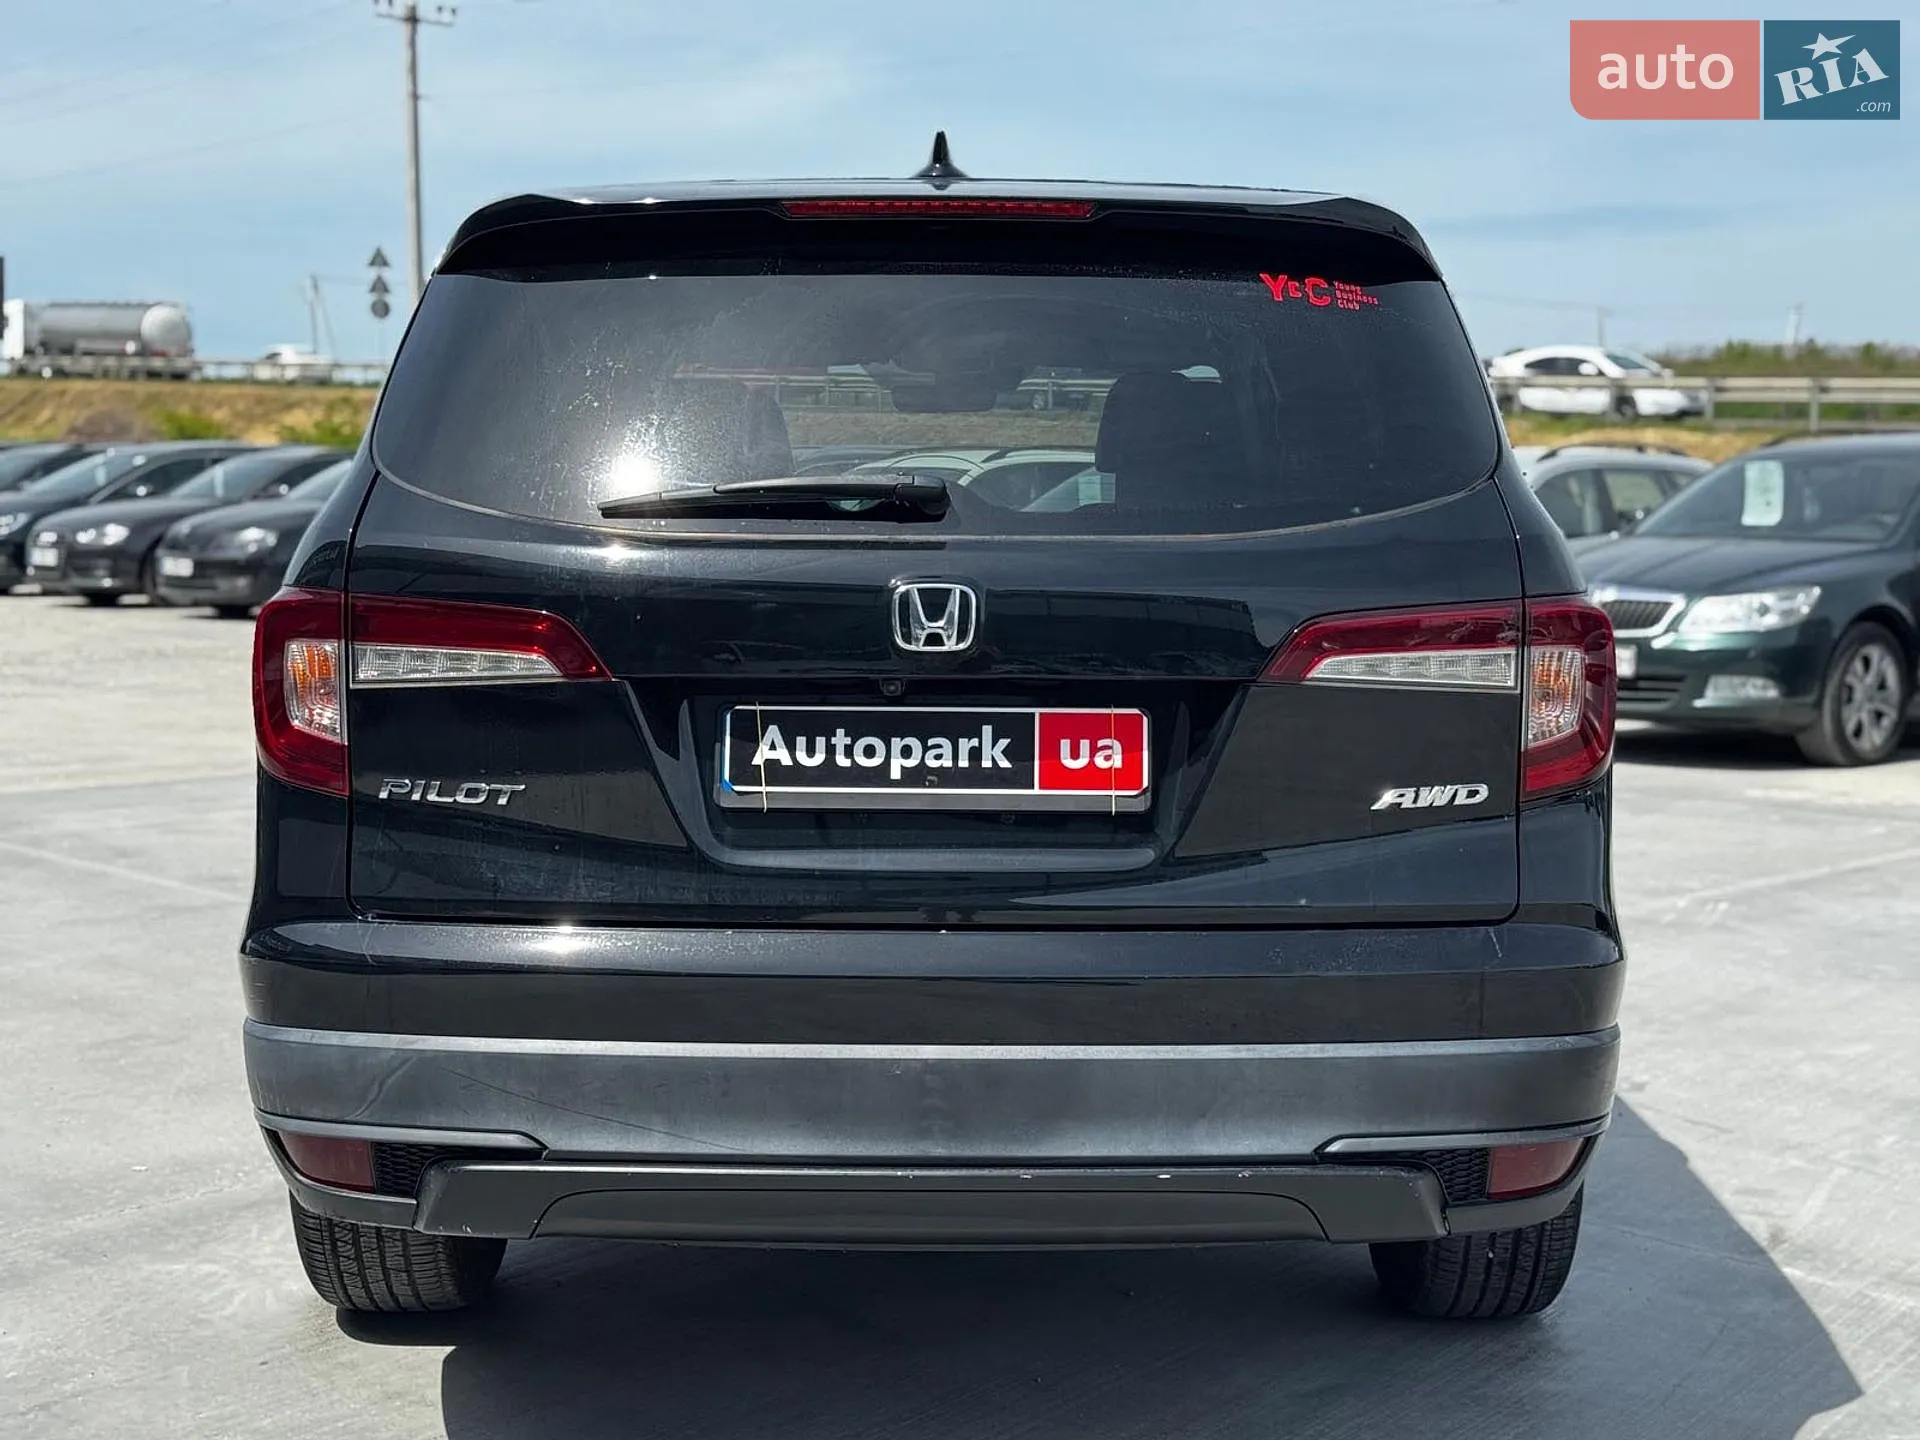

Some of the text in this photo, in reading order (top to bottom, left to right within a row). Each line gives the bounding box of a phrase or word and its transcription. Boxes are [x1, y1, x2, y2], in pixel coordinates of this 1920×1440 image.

[751, 724, 1124, 780] Autopark ua
[378, 778, 526, 806] PILOT
[1370, 783, 1489, 811] AWD
